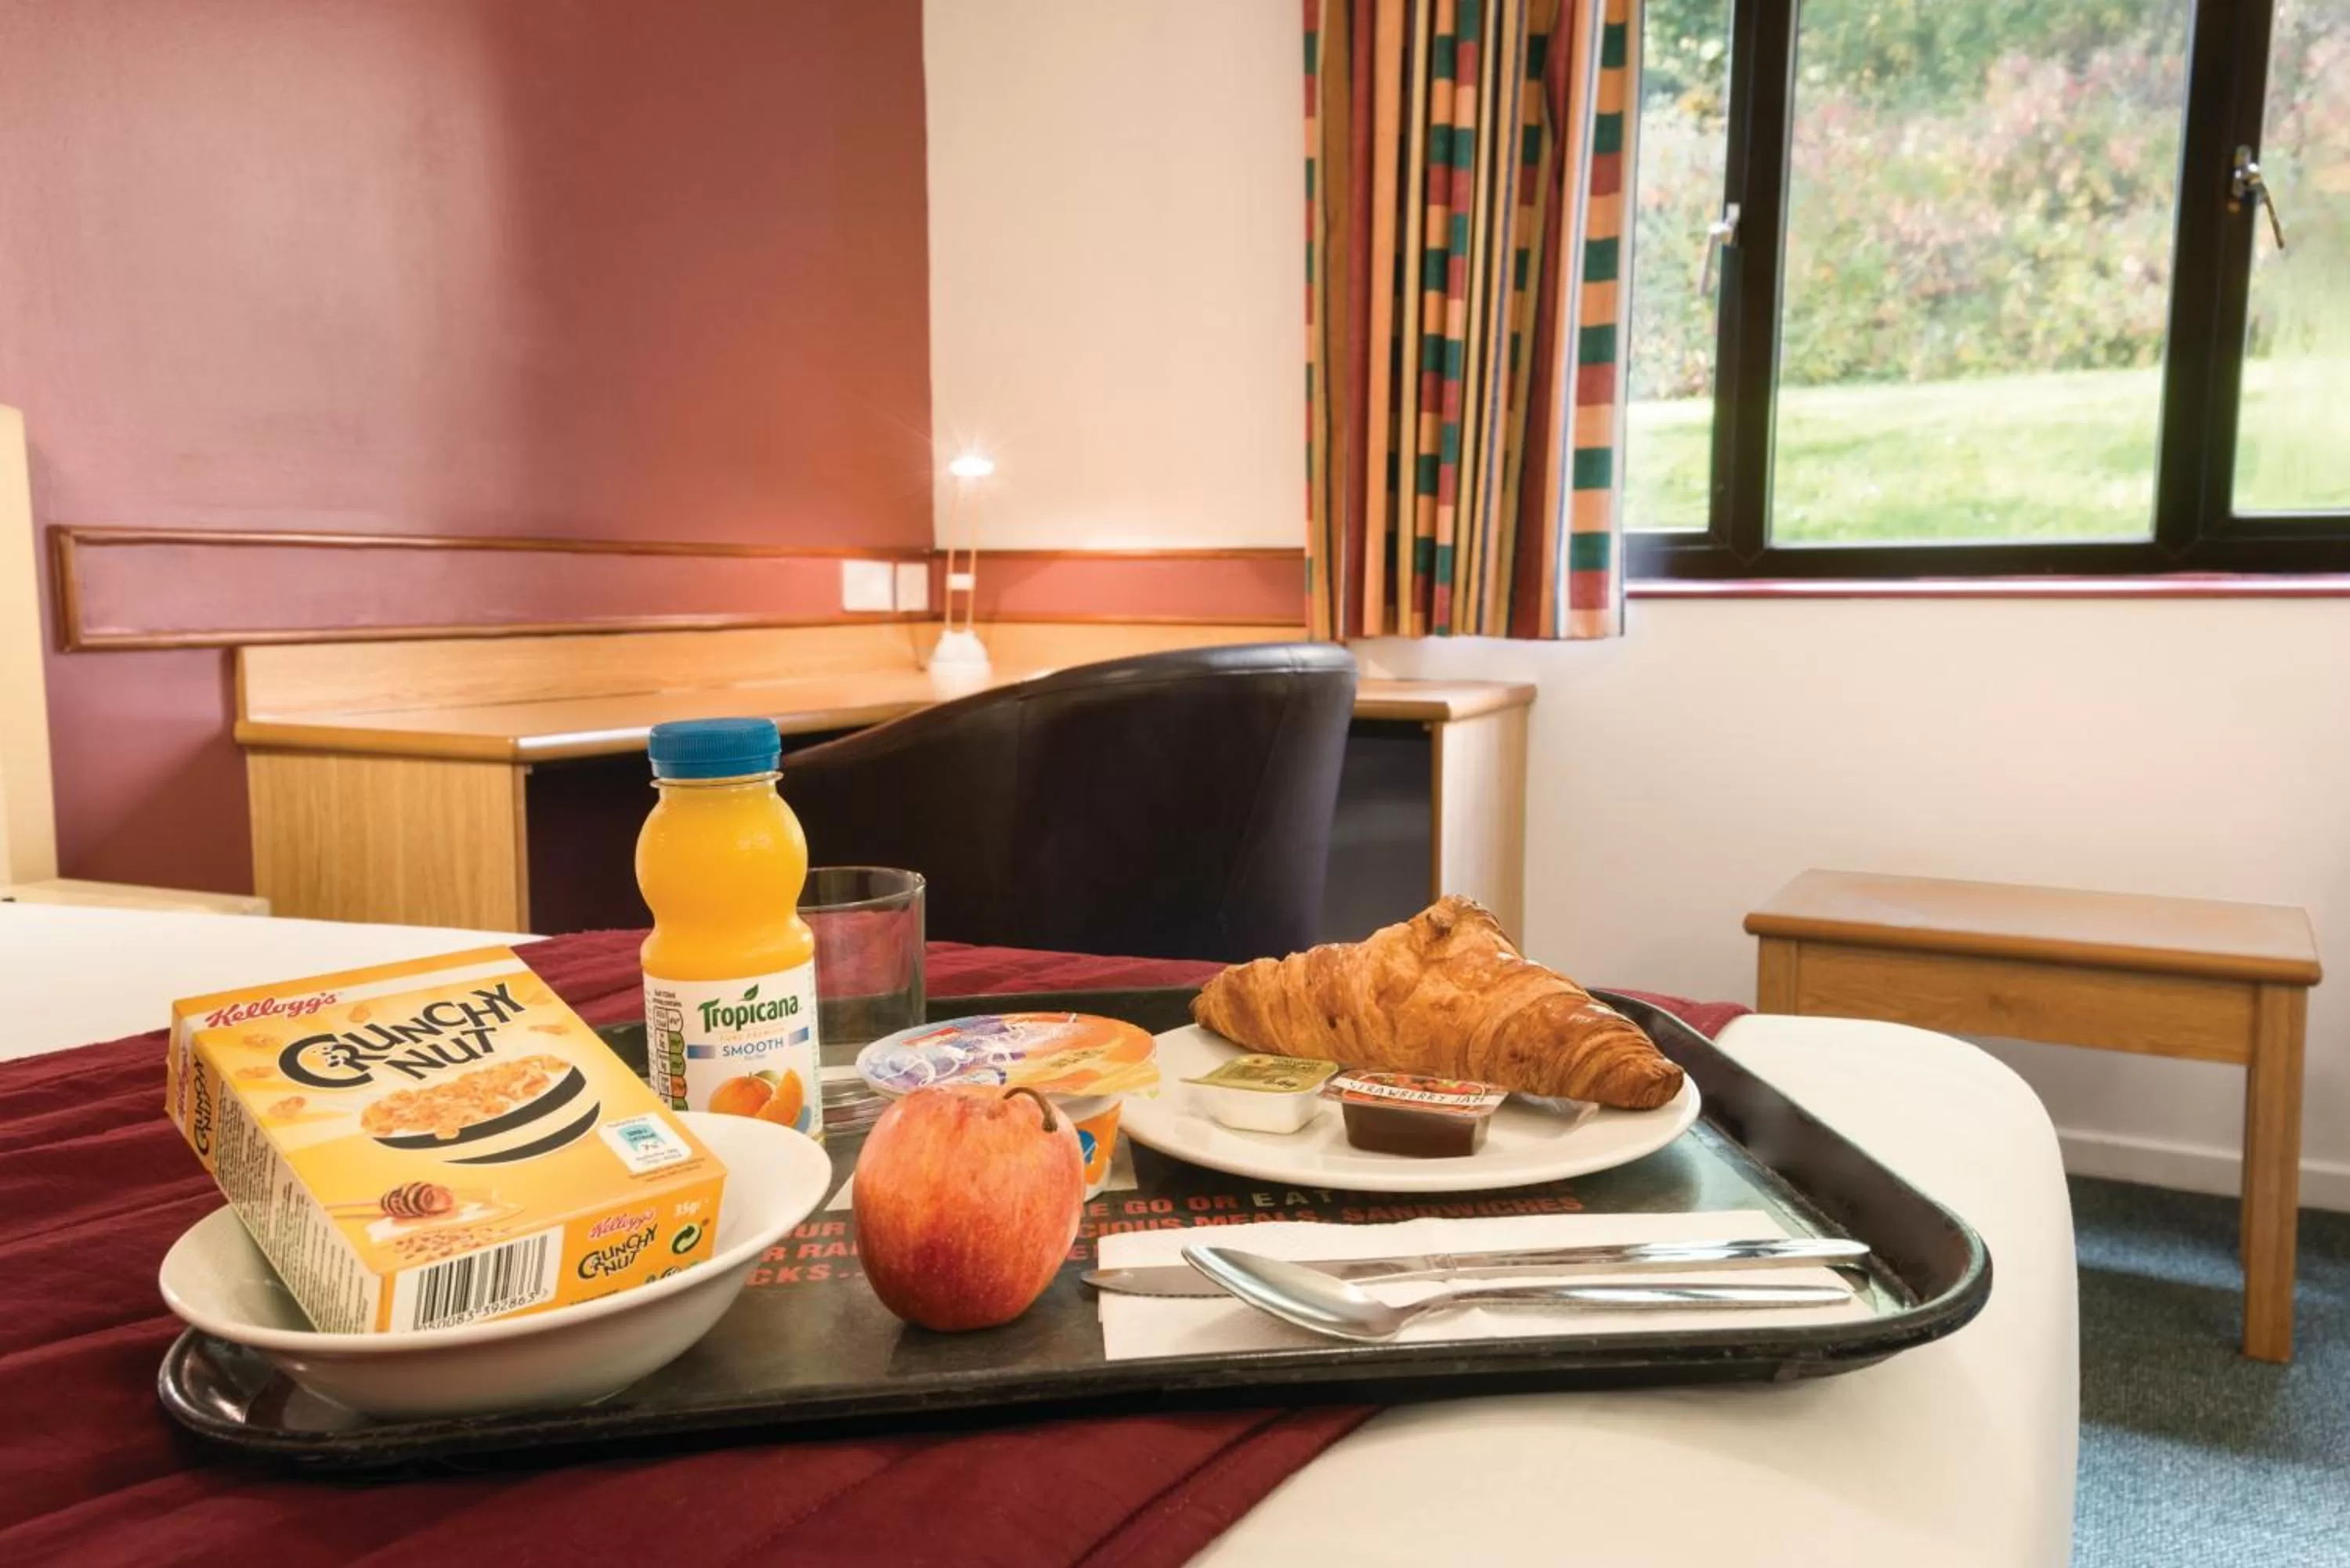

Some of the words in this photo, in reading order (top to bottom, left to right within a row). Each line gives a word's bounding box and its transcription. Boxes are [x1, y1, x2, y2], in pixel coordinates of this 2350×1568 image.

[204, 992, 337, 1028] Kellogg's
[698, 993, 798, 1034] Tropicana
[278, 982, 526, 1088] CRUNCHY
[383, 1027, 498, 1080] NUT
[722, 1036, 783, 1057] SMOOTH
[793, 1221, 846, 1238] UR
[1124, 1199, 1173, 1215] GO
[1252, 1190, 1332, 1208] EAT
[1078, 1216, 1182, 1238] CIOUS
